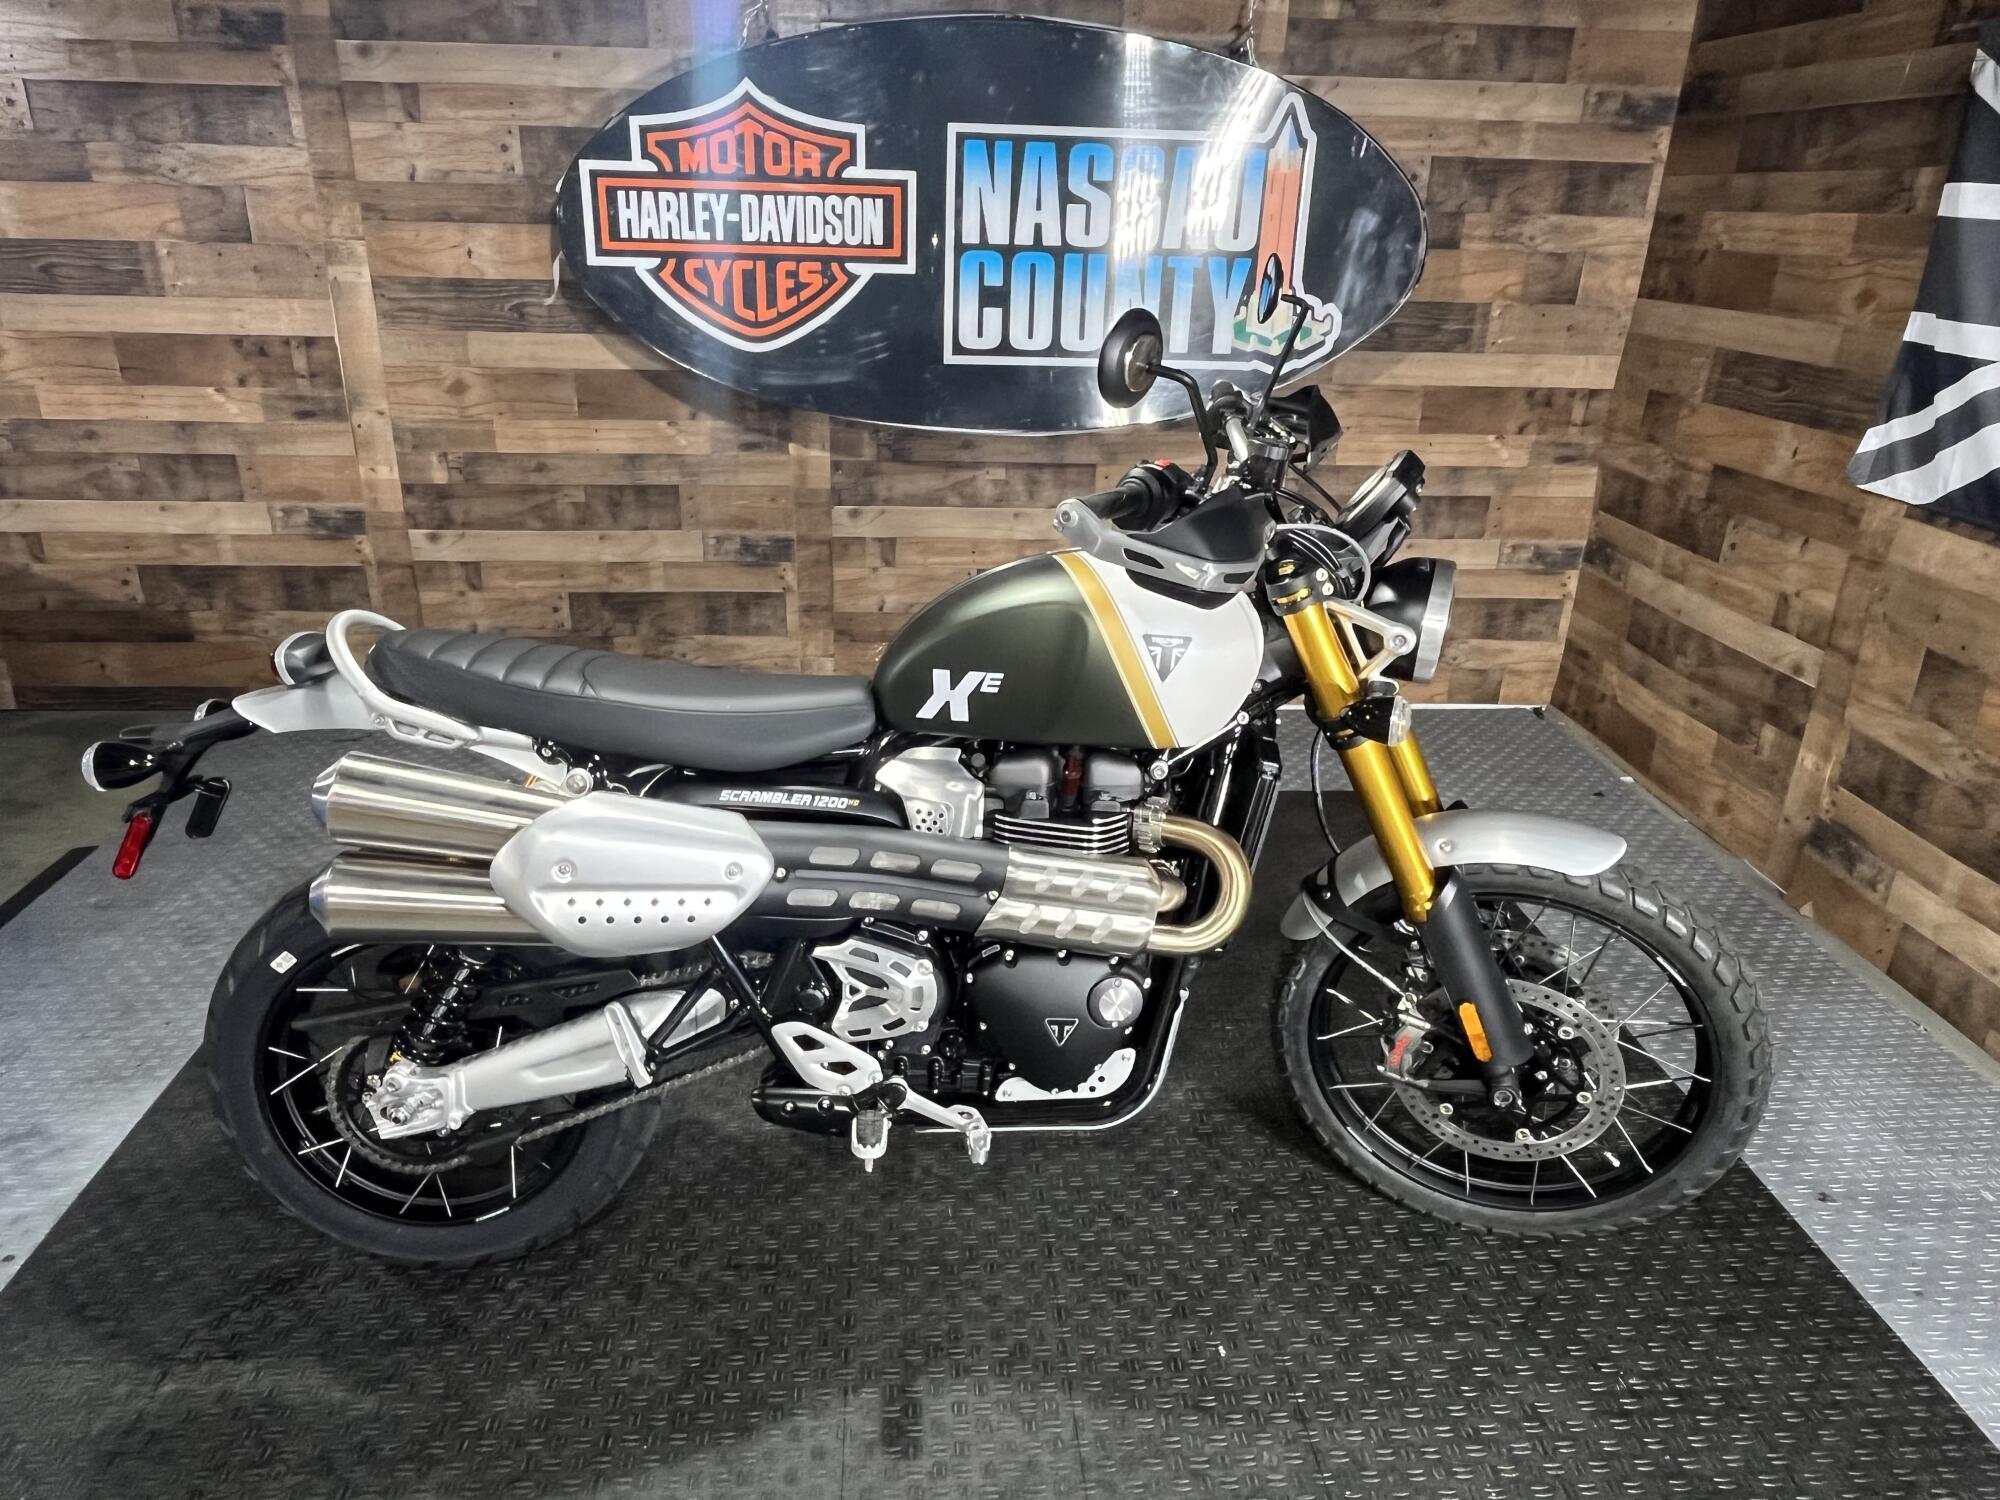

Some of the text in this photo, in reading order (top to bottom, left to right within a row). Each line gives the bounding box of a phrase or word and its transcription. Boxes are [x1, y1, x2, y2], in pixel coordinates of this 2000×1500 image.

[678, 118, 823, 177] MOTOR
[616, 190, 884, 246] HARLEY-DAVIDSON
[683, 257, 823, 322] CYCLES
[958, 250, 1253, 355] COUNTY
[719, 789, 814, 807] SCRAMBLER
